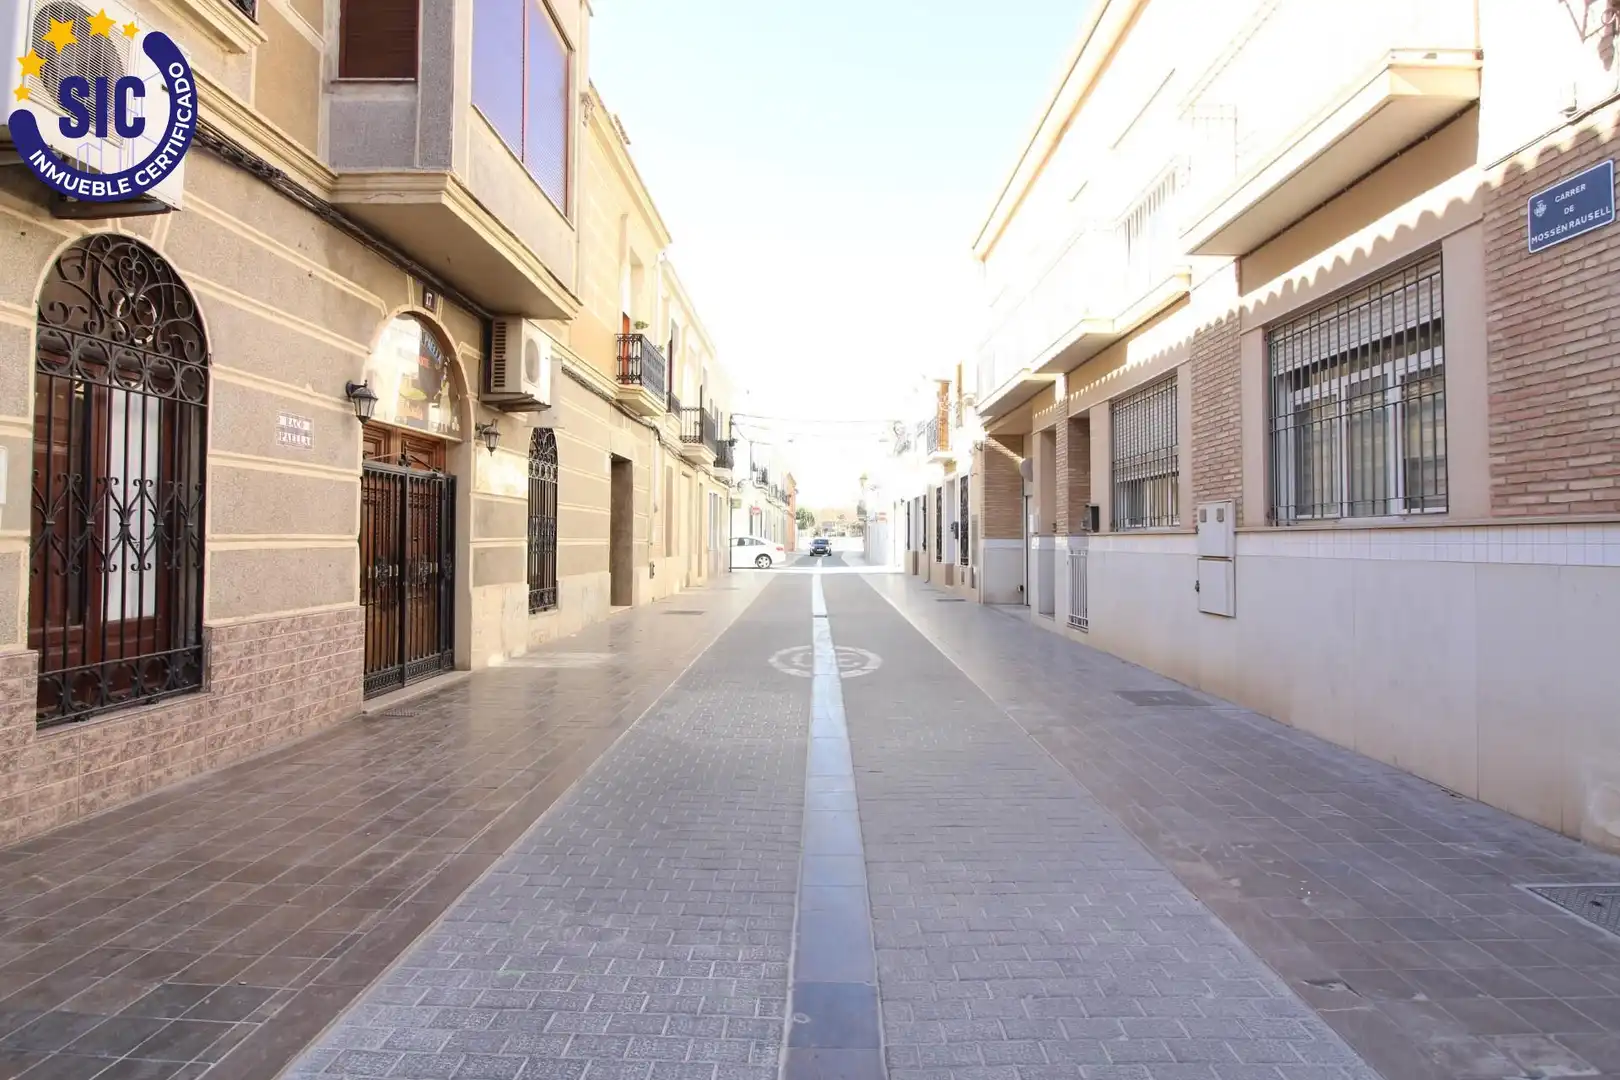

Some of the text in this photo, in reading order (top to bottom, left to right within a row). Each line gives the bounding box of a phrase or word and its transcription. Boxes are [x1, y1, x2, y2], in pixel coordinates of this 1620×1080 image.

[1554, 183, 1586, 202] CARRER
[1563, 204, 1575, 215] DE
[1569, 206, 1611, 229] RAUSELL
[426, 292, 432, 305] 17
